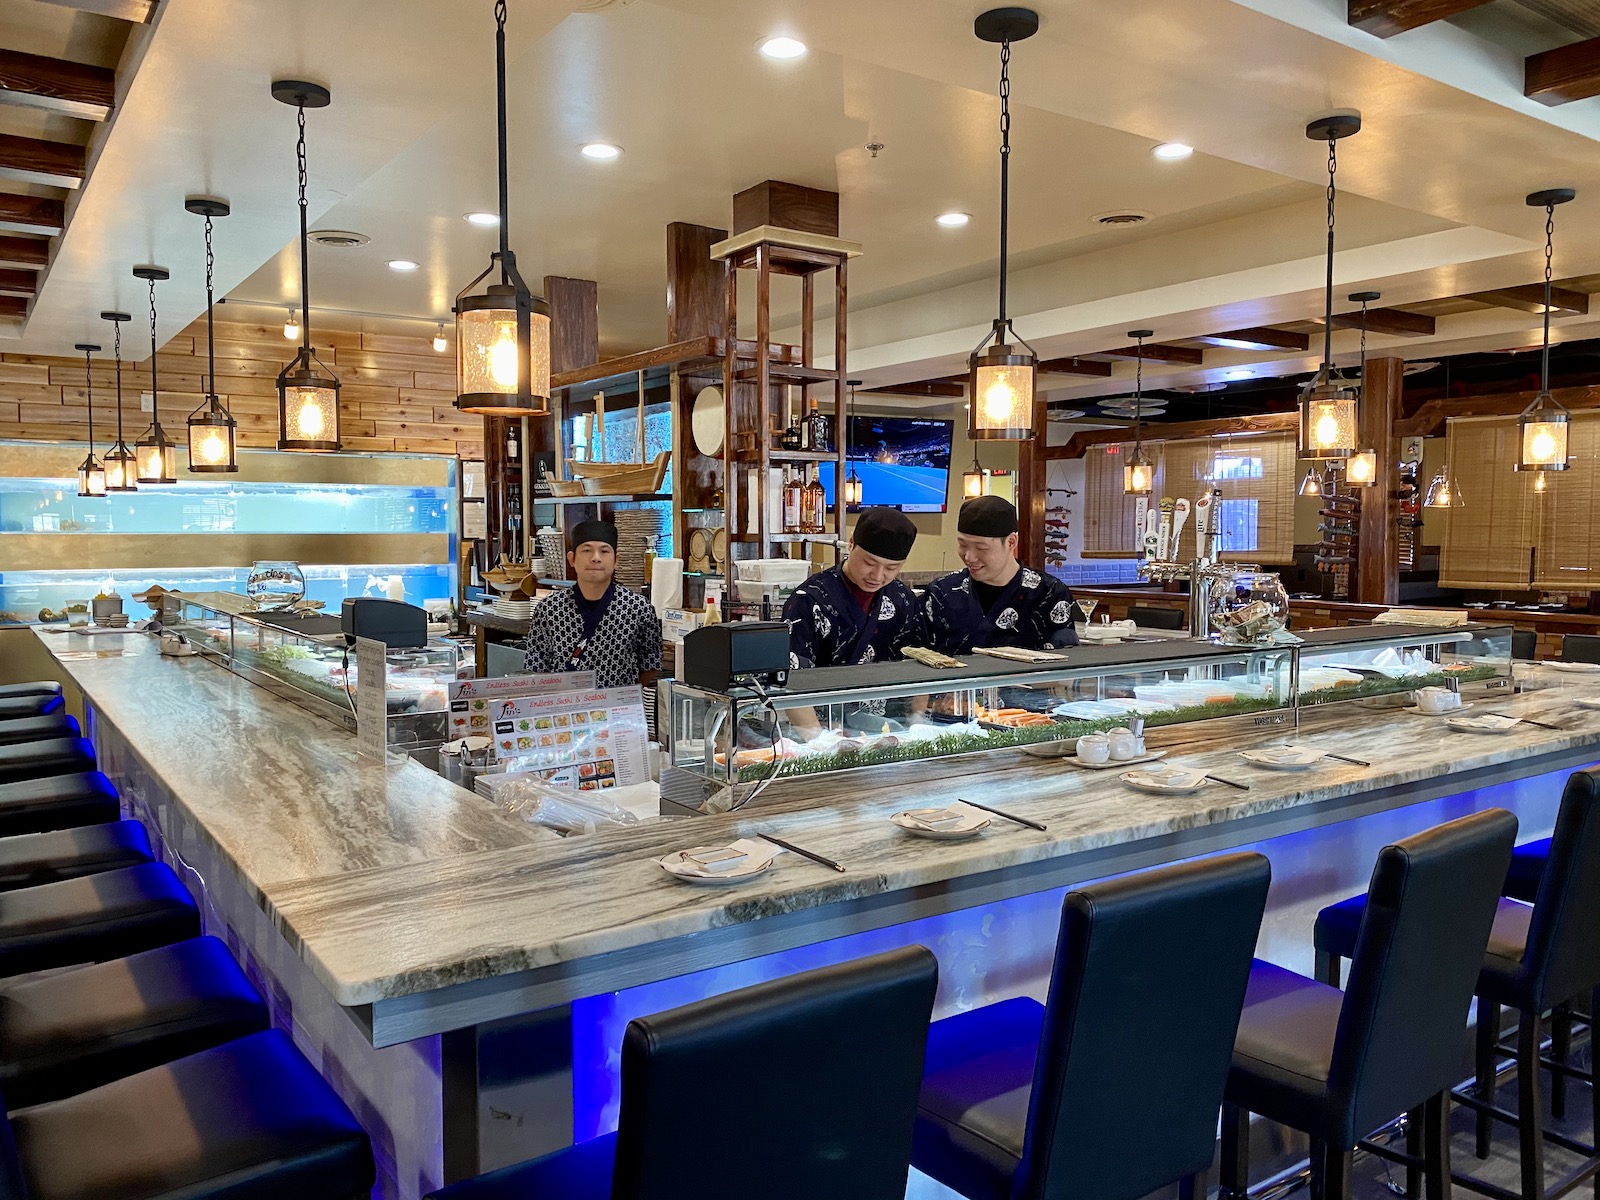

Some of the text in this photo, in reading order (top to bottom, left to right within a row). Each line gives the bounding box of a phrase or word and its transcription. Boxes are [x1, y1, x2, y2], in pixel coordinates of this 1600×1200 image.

[265, 569, 283, 579] tips
[539, 677, 562, 685] Seafood
[529, 700, 553, 708] Endless
[556, 696, 573, 705] Sushi
[576, 695, 581, 703] &
[584, 693, 607, 702] Seafood
